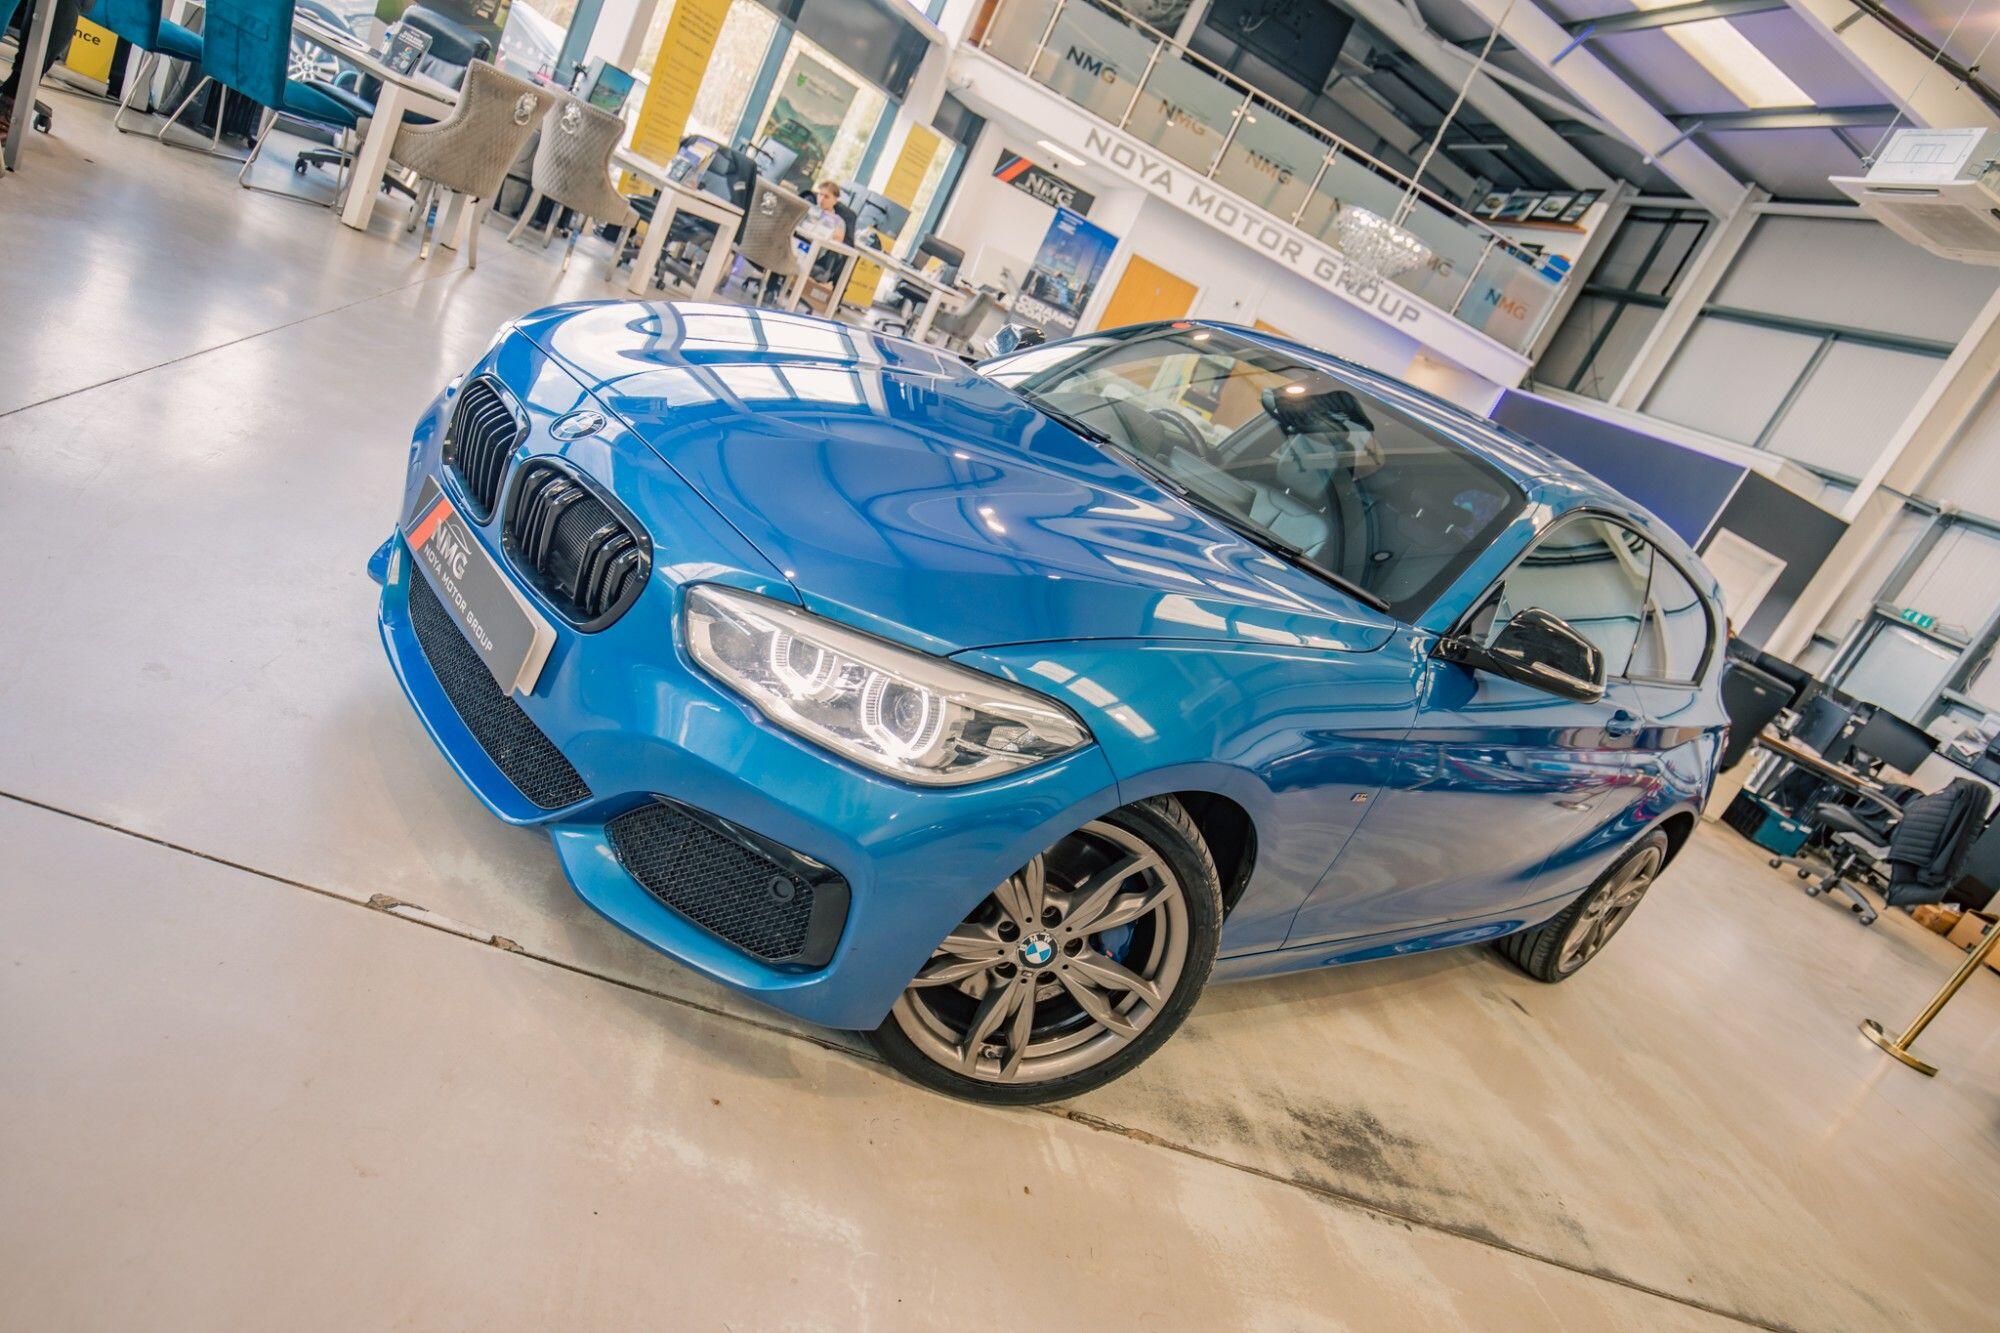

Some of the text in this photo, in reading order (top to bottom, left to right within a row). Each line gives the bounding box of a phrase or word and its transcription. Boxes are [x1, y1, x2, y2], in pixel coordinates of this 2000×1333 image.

[1066, 45, 1117, 84] NMG
[1158, 99, 1206, 136] NMG
[1245, 149, 1293, 185] NMG
[1024, 172, 1075, 208] NMG
[1085, 128, 1420, 323] NOYA MOTOR GROUP
[1484, 288, 1528, 320] NMG
[431, 517, 469, 580] NMG
[423, 543, 494, 652] NOYA MOTOR GROUP
